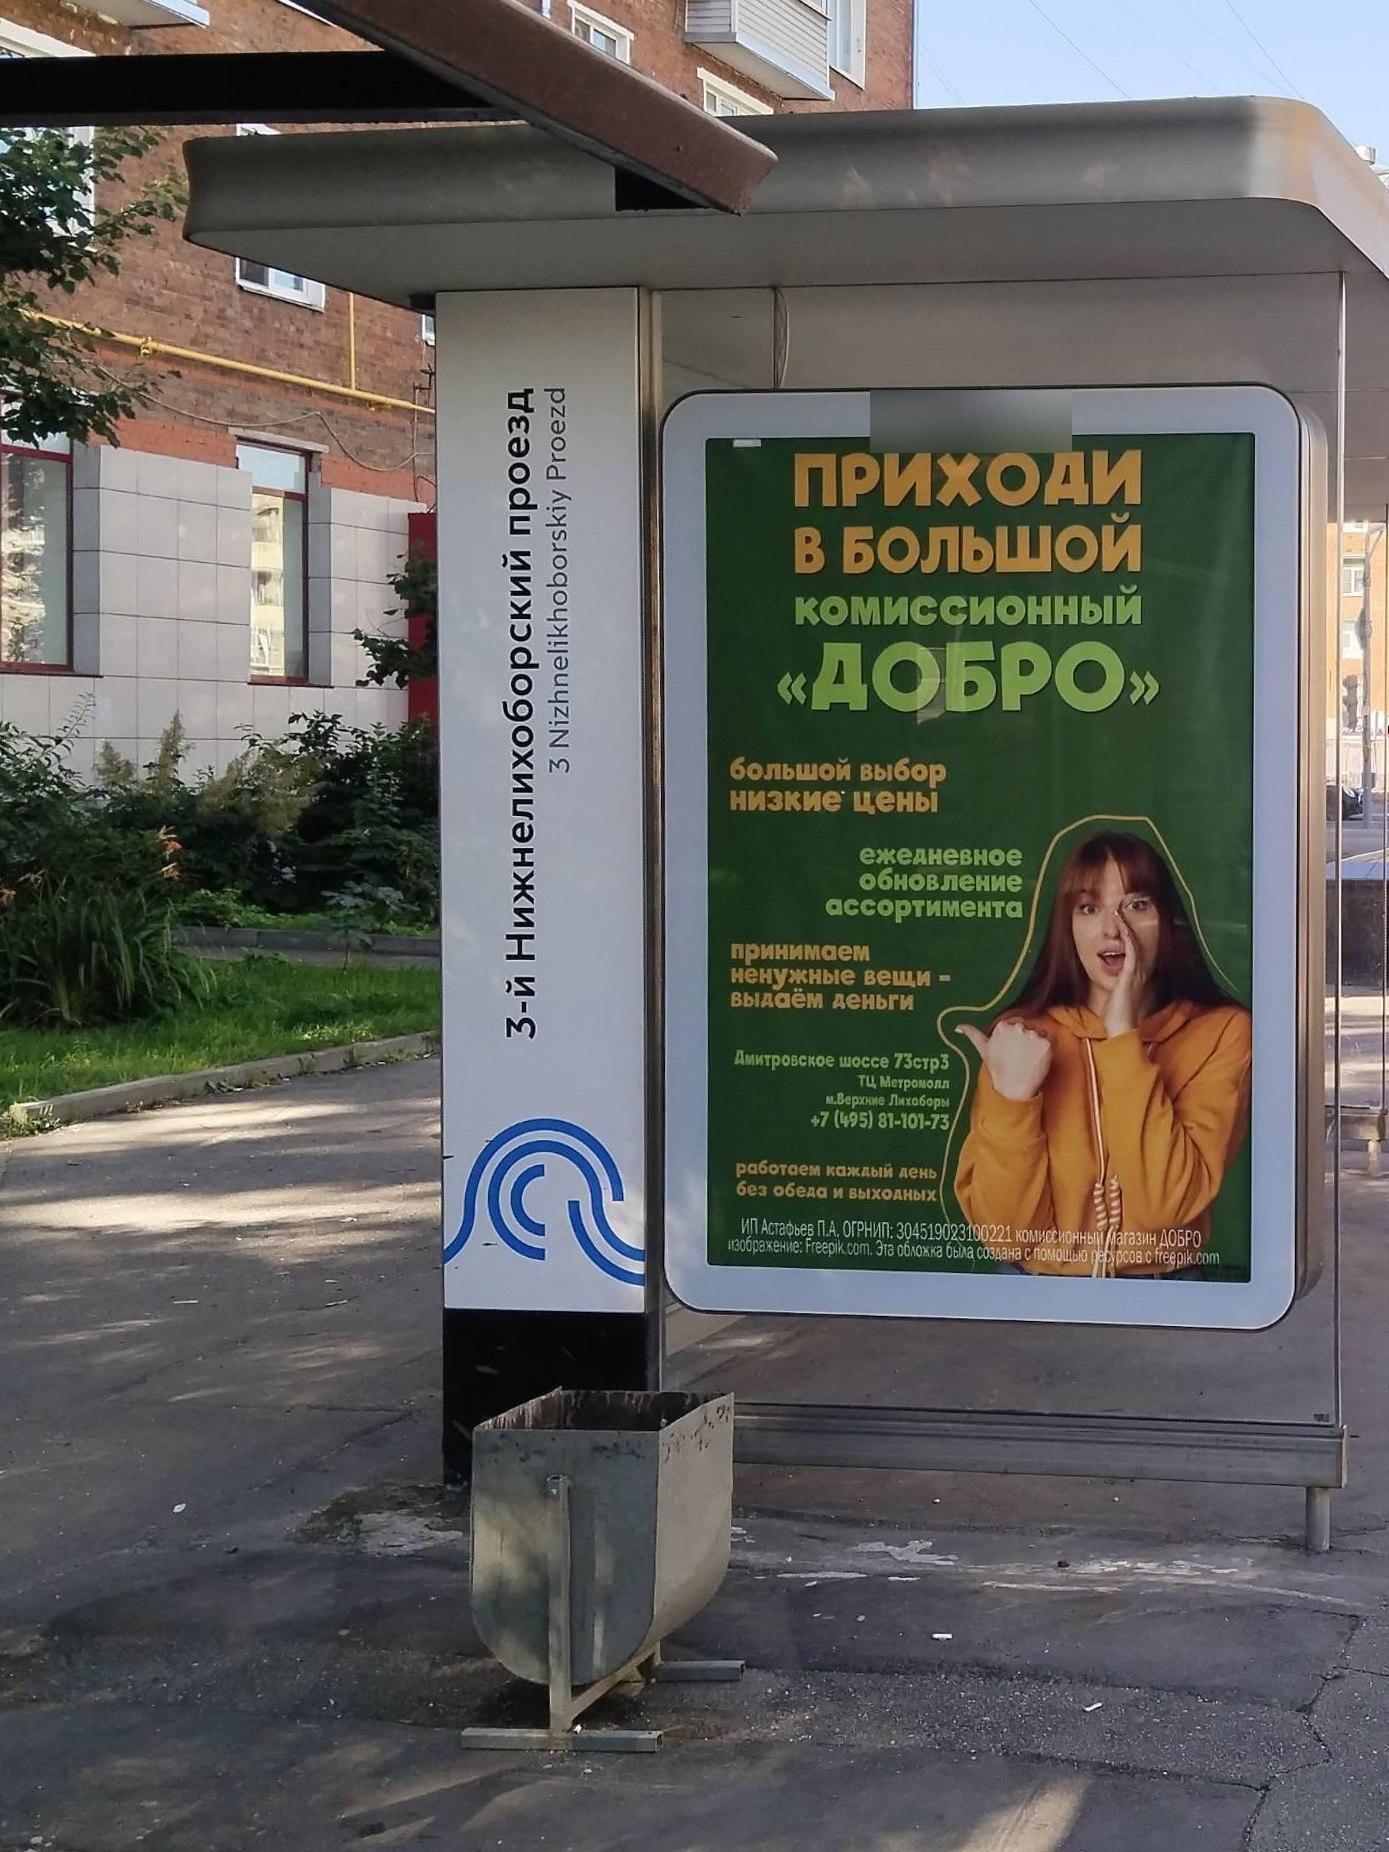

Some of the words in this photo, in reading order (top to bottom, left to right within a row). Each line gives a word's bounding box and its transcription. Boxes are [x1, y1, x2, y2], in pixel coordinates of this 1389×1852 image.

[543, 387, 566, 480] Proezd
[507, 388, 538, 535] проезд
[793, 450, 1143, 508] ПРИХОДИ
[795, 526, 825, 574] В
[843, 512, 1142, 574] БОЛЬШОЙ
[544, 489, 572, 747] Nizhnelikhoborskiy
[776, 641, 1160, 712] «ДОБРО»
[501, 550, 539, 960] Нижнелихоборский
[549, 758, 570, 773] 3
[730, 757, 851, 782] большой
[860, 757, 946, 788] выбор
[730, 790, 842, 812] низкие
[854, 790, 938, 815] цены
[859, 847, 1023, 867] ежедневное
[859, 868, 1023, 892] обновление
[825, 898, 1023, 923] ассортимента
[730, 943, 870, 966] принимаем
[730, 967, 856, 990] ненужные
[864, 969, 931, 988] вещи
[505, 976, 536, 1039] 3-й
[730, 989, 823, 1009] выдаём
[832, 992, 914, 1010] деньги
[734, 1050, 835, 1071] Дмитровское
[839, 1055, 889, 1068] шоссе
[893, 1053, 949, 1074] 73стр3
[858, 1075, 877, 1089] ТЦ
[879, 1076, 950, 1092] Метромолл
[888, 1094, 950, 1110] Лихоборы
[810, 1111, 829, 1127] +7
[834, 1110, 873, 1129] (495)
[878, 1112, 949, 1130] 81-101-73
[736, 1160, 821, 1177] работаем
[826, 1163, 894, 1179] каждый
[899, 1168, 937, 1180] день
[736, 1181, 768, 1197] без
[773, 1183, 828, 1199] обеда
[833, 1188, 843, 1199] и
[849, 1188, 937, 1202] выходных
[741, 1217, 758, 1235] ИП
[761, 1217, 815, 1239] Астафьев
[817, 1219, 840, 1238] П.А.
[842, 1220, 893, 1240] ОГРНИП:
[896, 1221, 1013, 1243] 304519023100221
[1159, 1229, 1201, 1249] ДОБРО
[728, 1235, 803, 1255] изображение:
[875, 1240, 894, 1257] Эта
[897, 1241, 943, 1258] обложка
[946, 1241, 974, 1260] была
[977, 1246, 1022, 1262] создана
[1033, 1248, 1088, 1265] помощью
[1154, 1249, 1220, 1268] freepik.com
